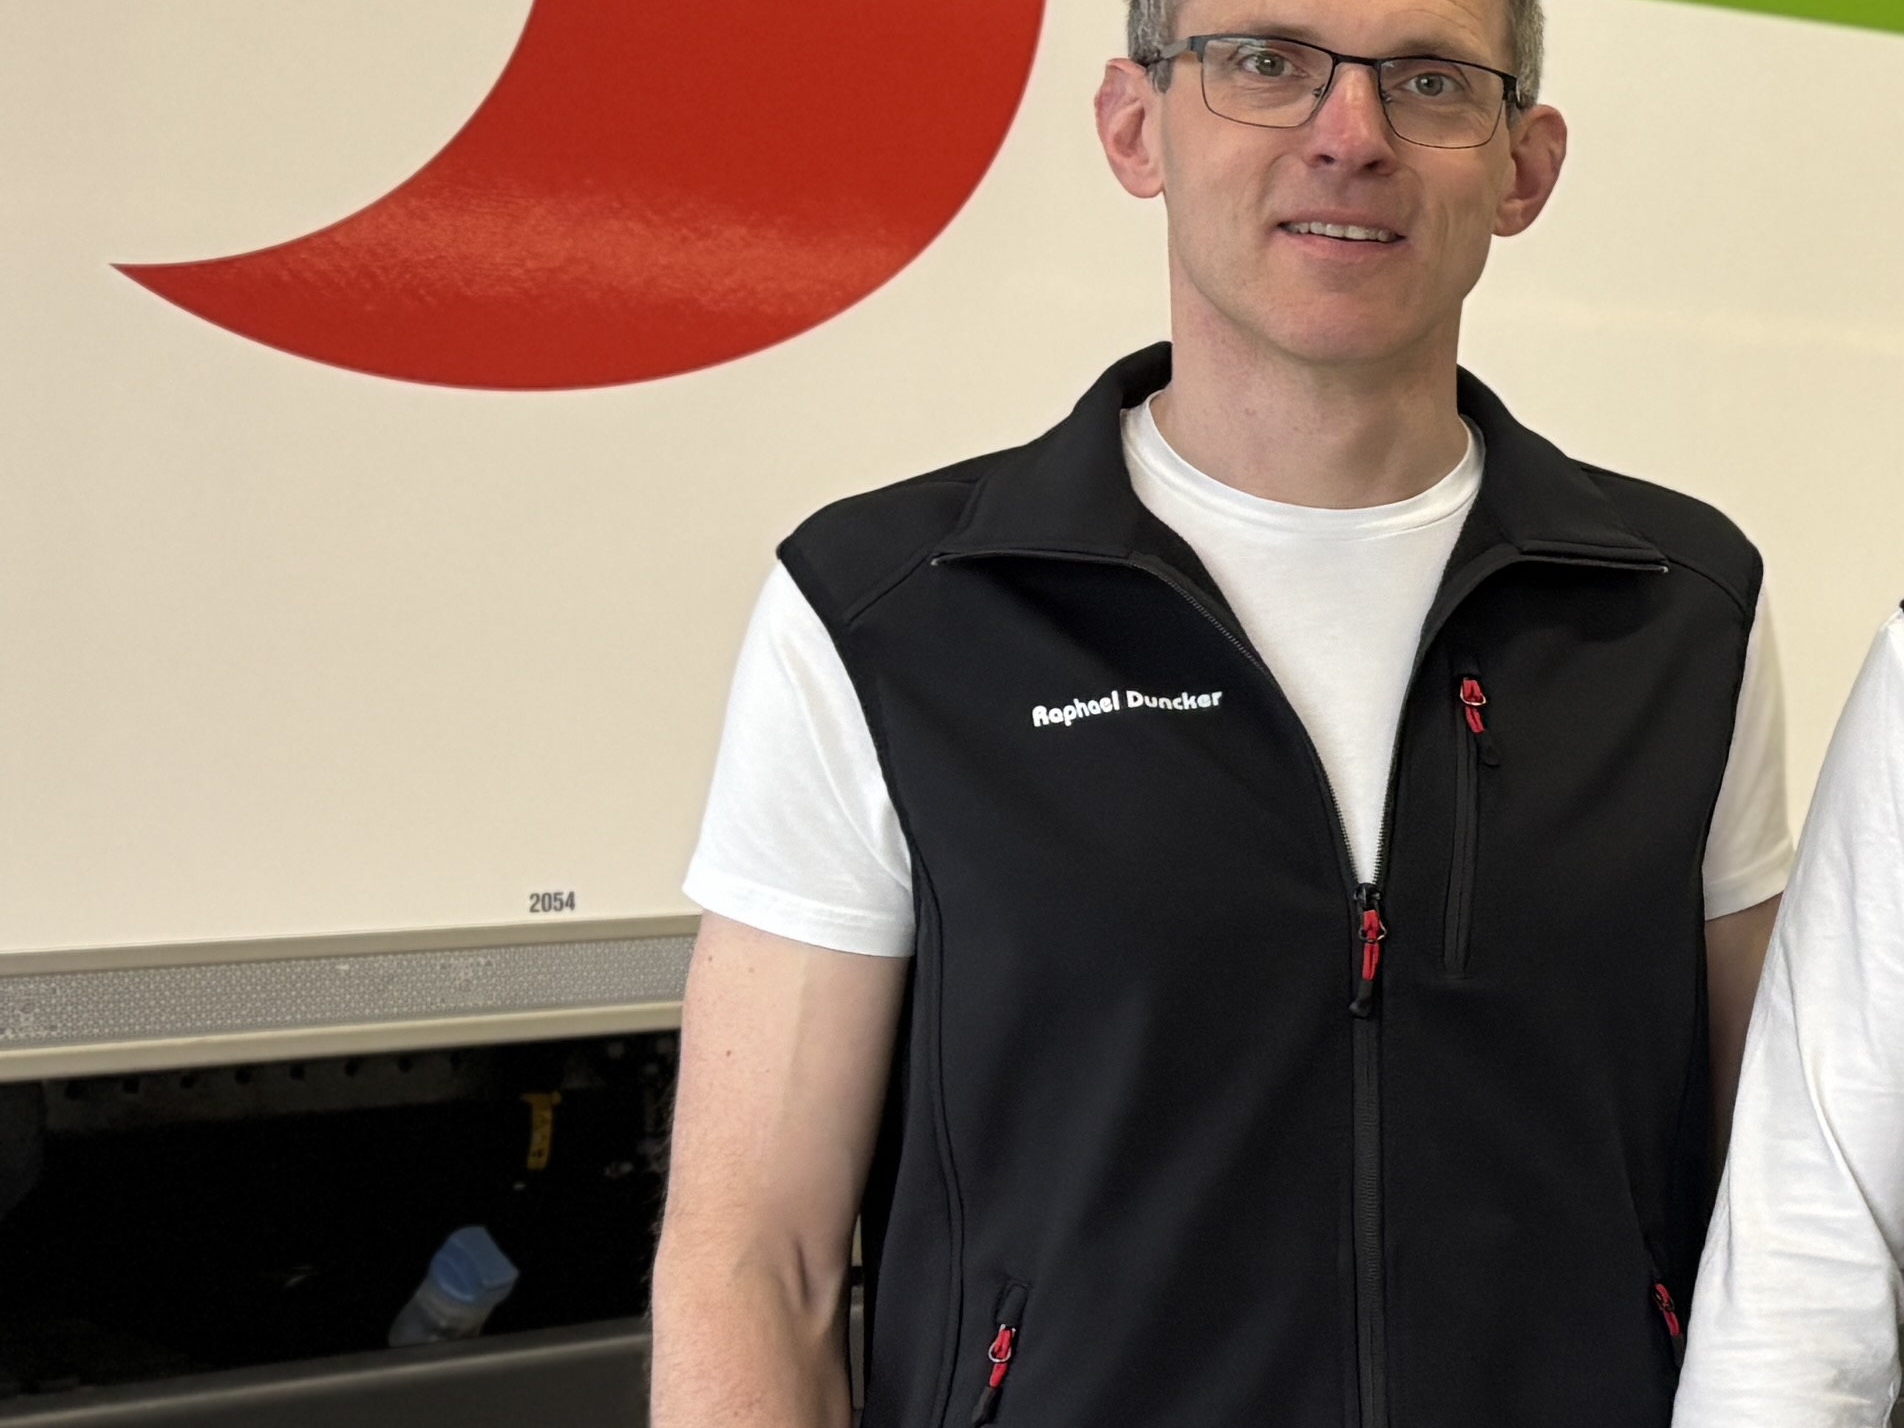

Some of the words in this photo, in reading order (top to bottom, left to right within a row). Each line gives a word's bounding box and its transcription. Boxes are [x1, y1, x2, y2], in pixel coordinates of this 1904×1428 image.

[1032, 690, 1120, 727] Raphael
[1126, 689, 1223, 711] Duncker
[528, 890, 577, 914] 2054
